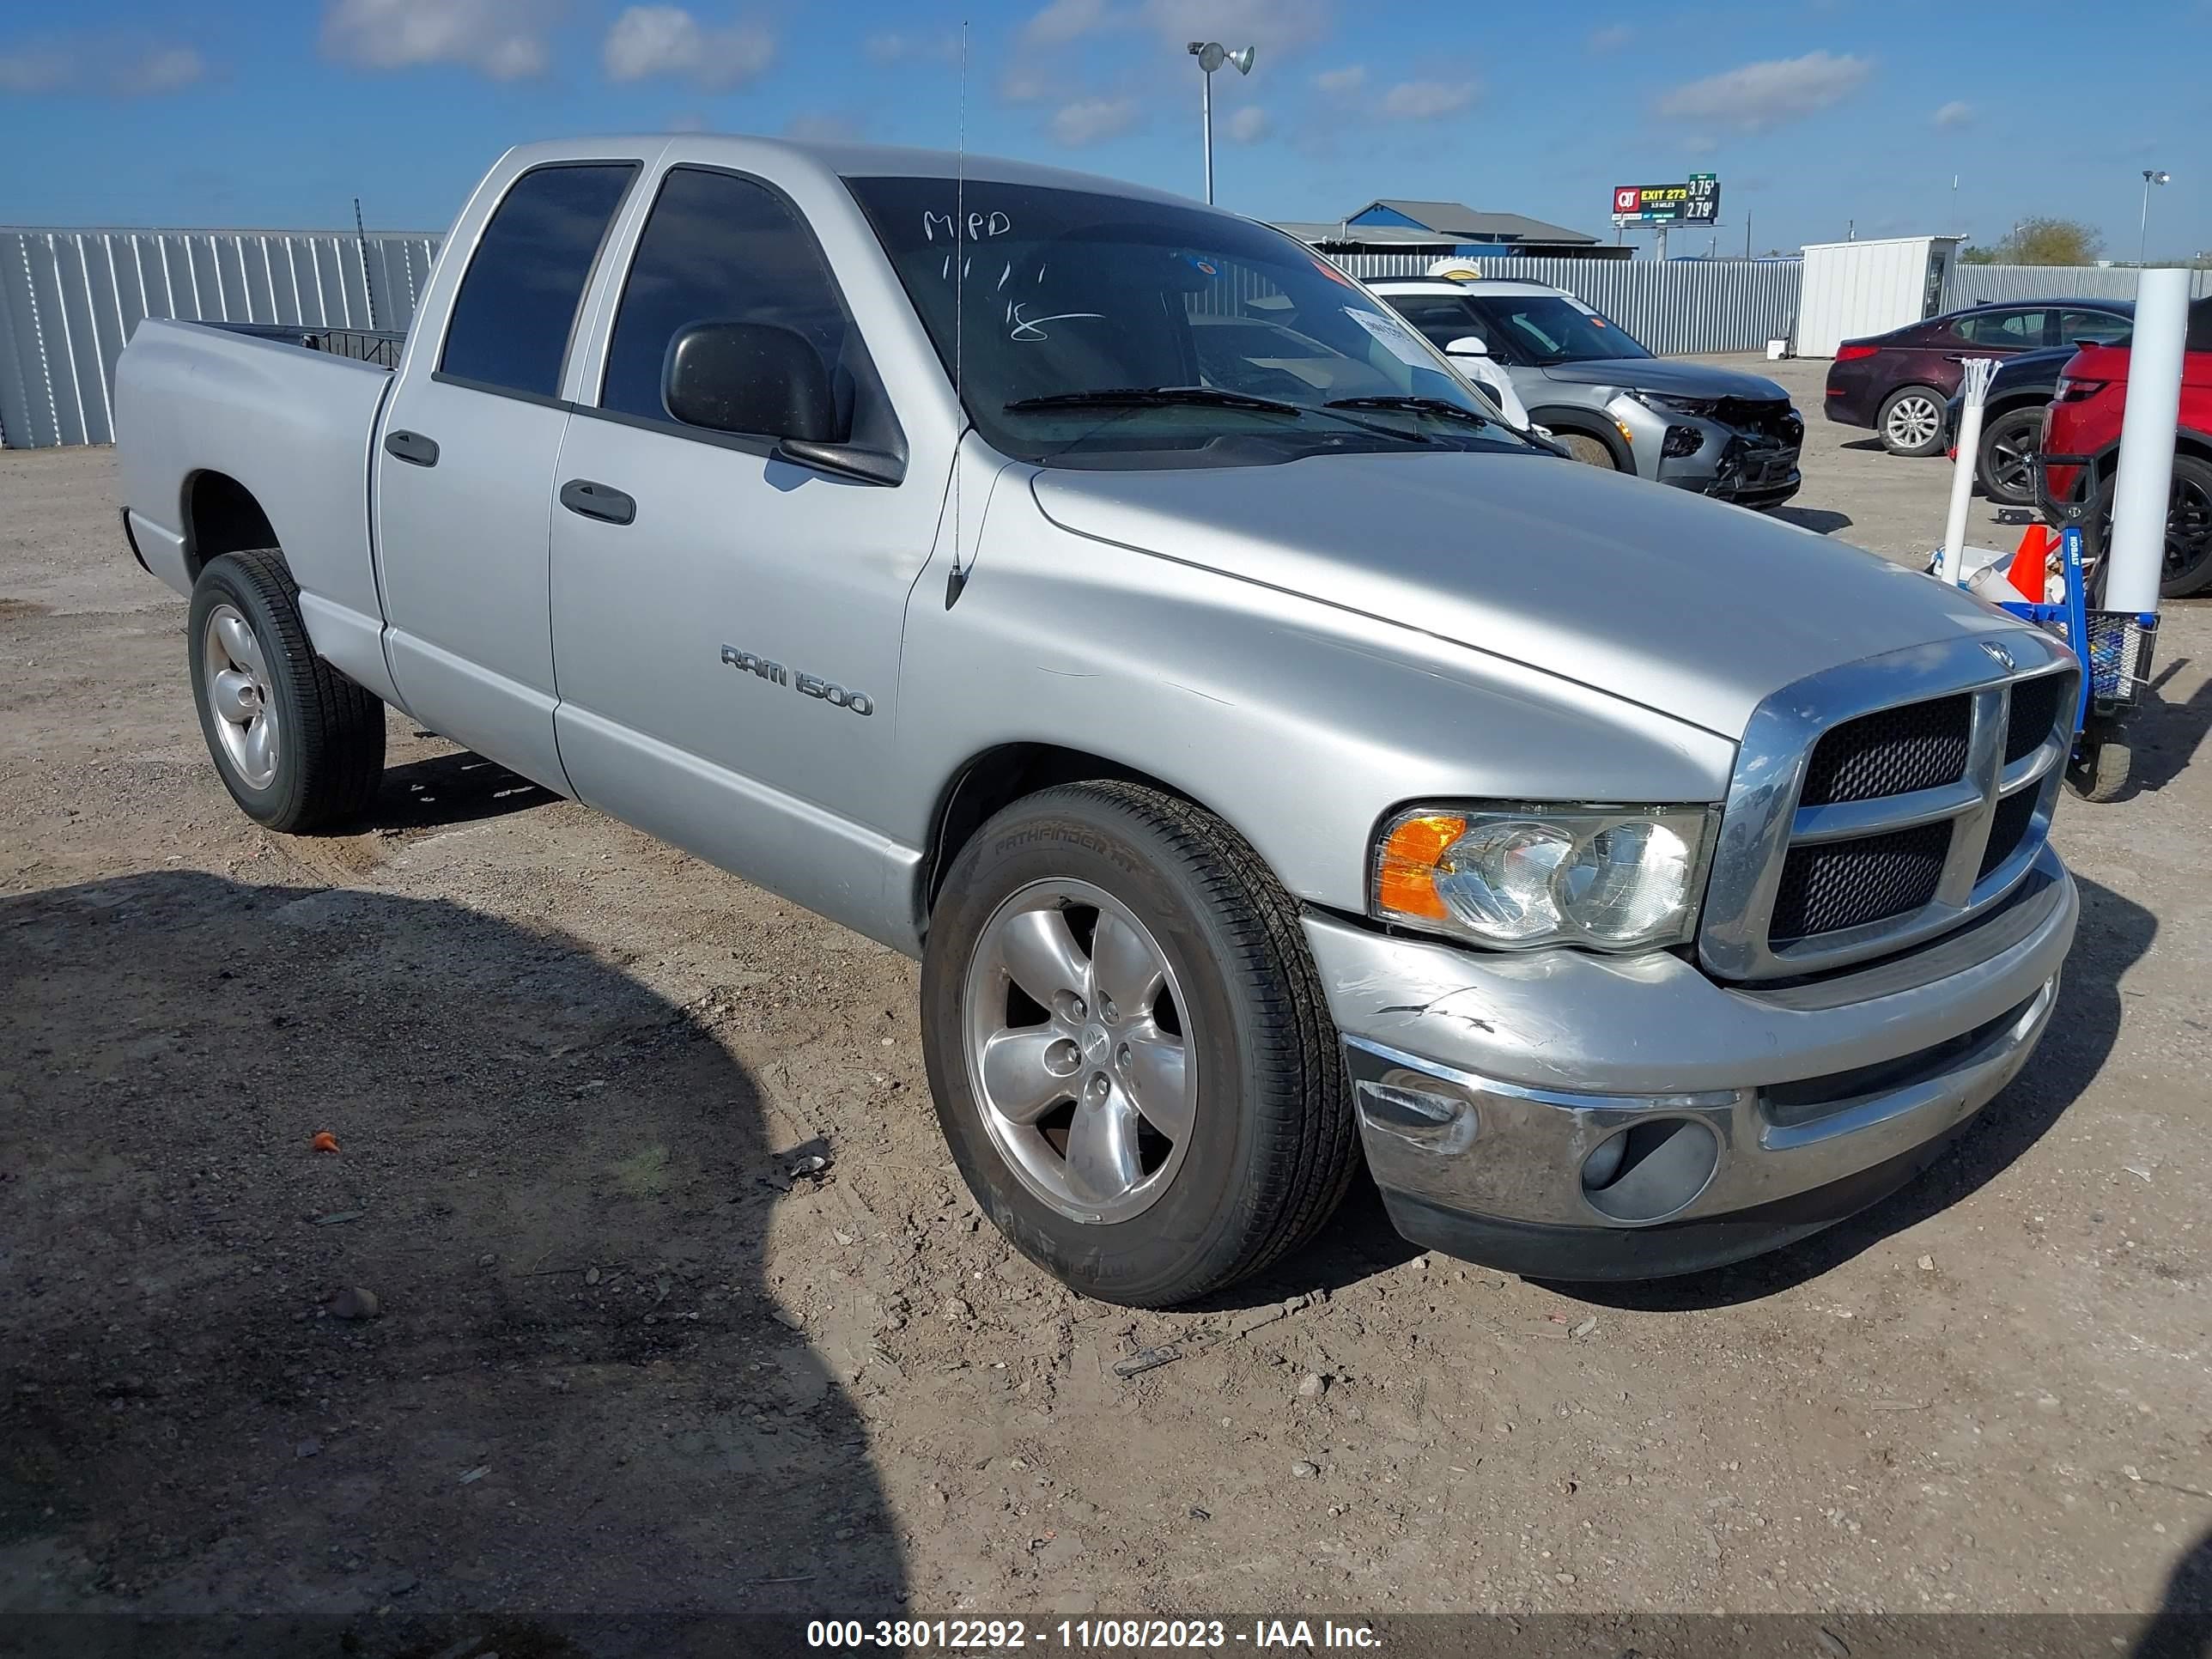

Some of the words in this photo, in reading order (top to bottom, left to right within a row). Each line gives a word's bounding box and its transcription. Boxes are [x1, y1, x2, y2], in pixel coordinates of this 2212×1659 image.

[1618, 191, 1637, 208] QT
[1641, 190, 1664, 201] EXIT
[1667, 189, 1687, 199] 273
[2069, 536, 2080, 566] KOBALT
[720, 642, 787, 688] RAM
[794, 670, 874, 717] 1500
[995, 825, 1108, 855] PATHFINDER
